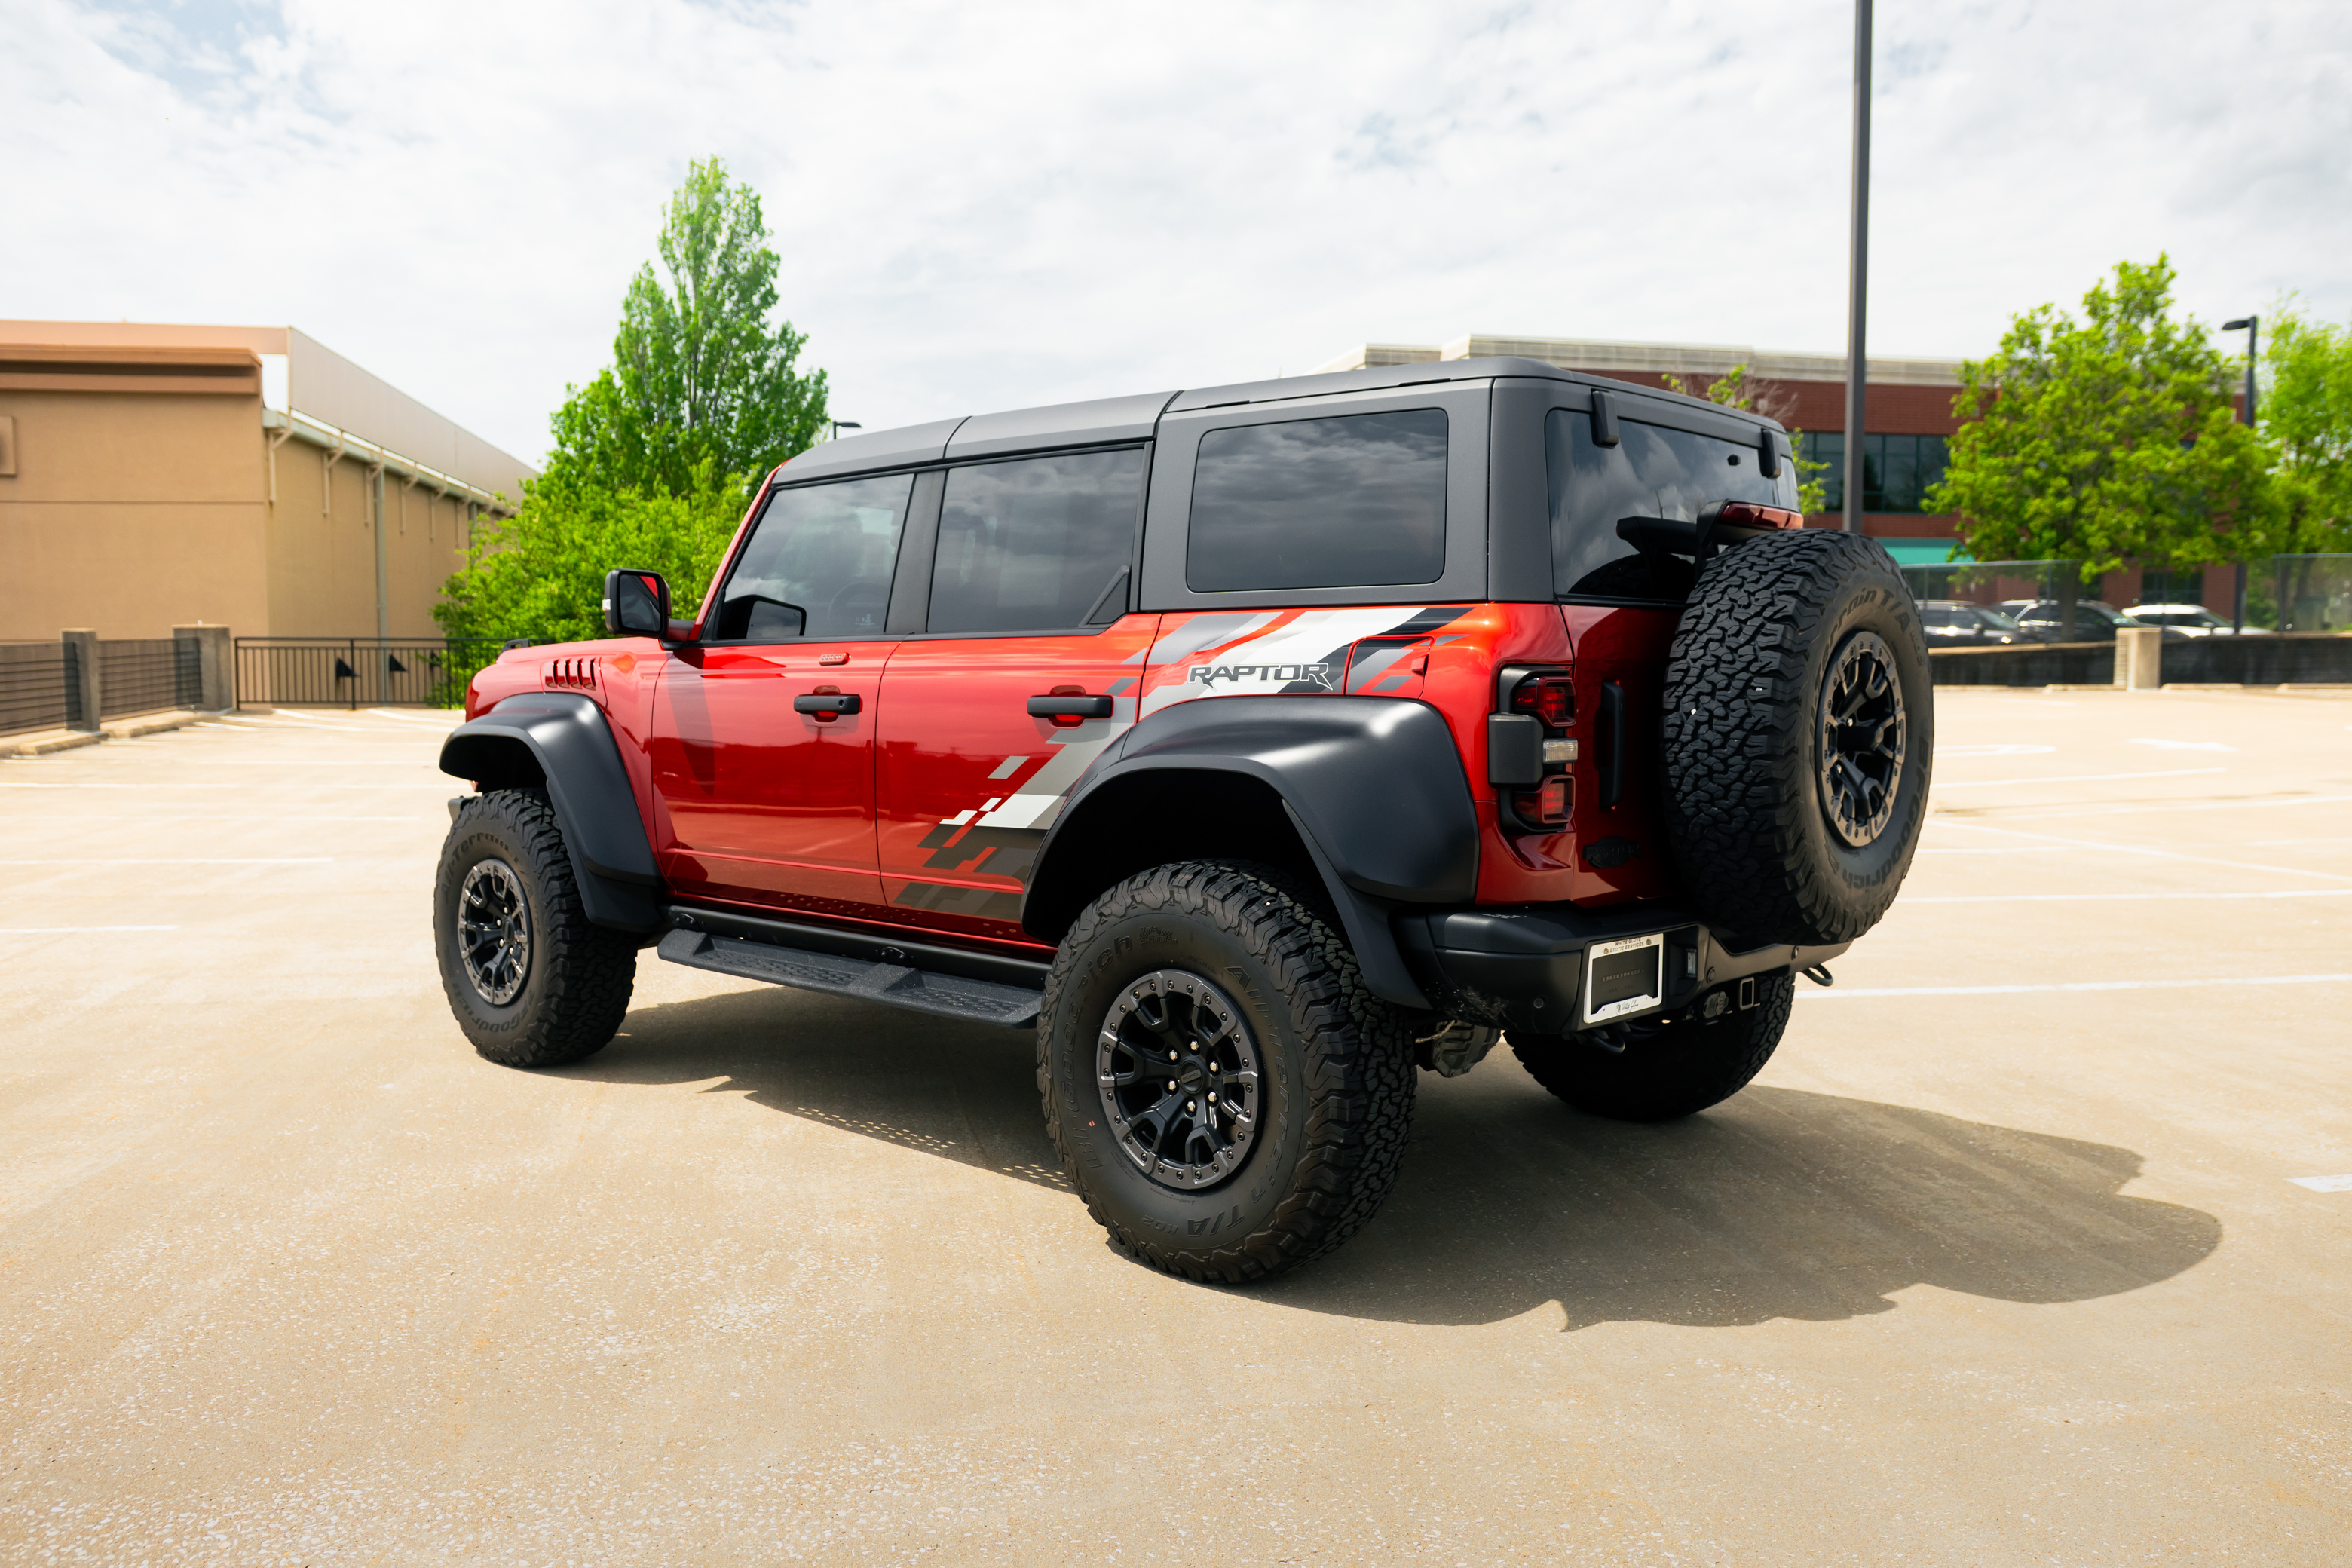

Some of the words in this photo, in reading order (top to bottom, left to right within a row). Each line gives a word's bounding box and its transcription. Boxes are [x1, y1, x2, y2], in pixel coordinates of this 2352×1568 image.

[1879, 587, 1911, 633] T/A
[1187, 663, 1334, 691] RAPTOR
[1842, 736, 1929, 893] BFGoodrich
[1625, 942, 1644, 950] SERVICES
[1602, 969, 1644, 982] BRONCO
[1061, 936, 1132, 1169] BFGoodrich
[1224, 965, 1290, 1203] All-Terrain
[1140, 1214, 1179, 1236] KO2
[1187, 1203, 1245, 1239] T/A
